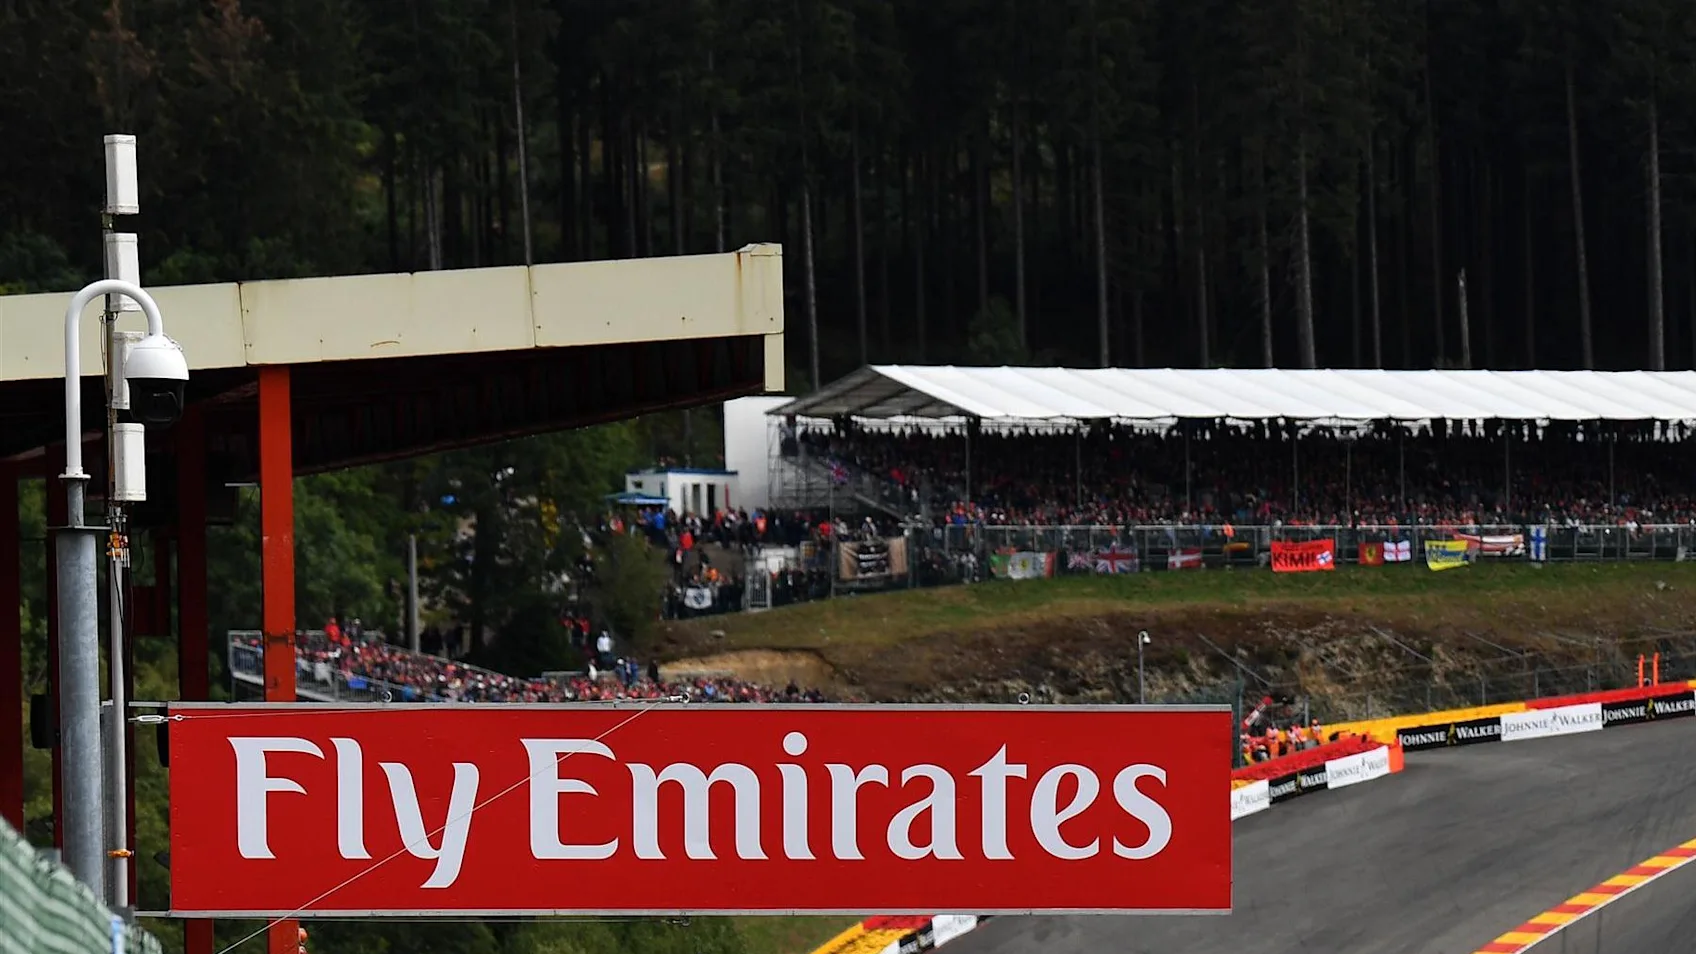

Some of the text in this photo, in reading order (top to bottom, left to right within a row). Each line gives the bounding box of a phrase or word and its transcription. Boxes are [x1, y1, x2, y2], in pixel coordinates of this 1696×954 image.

[1602, 699, 1696, 723] JOHNNIE WALKER
[1400, 724, 1500, 747] JOHNNIE WALKER
[1504, 713, 1600, 736] JOHNNIE WALKER
[226, 731, 1171, 889] Fly Emirates
